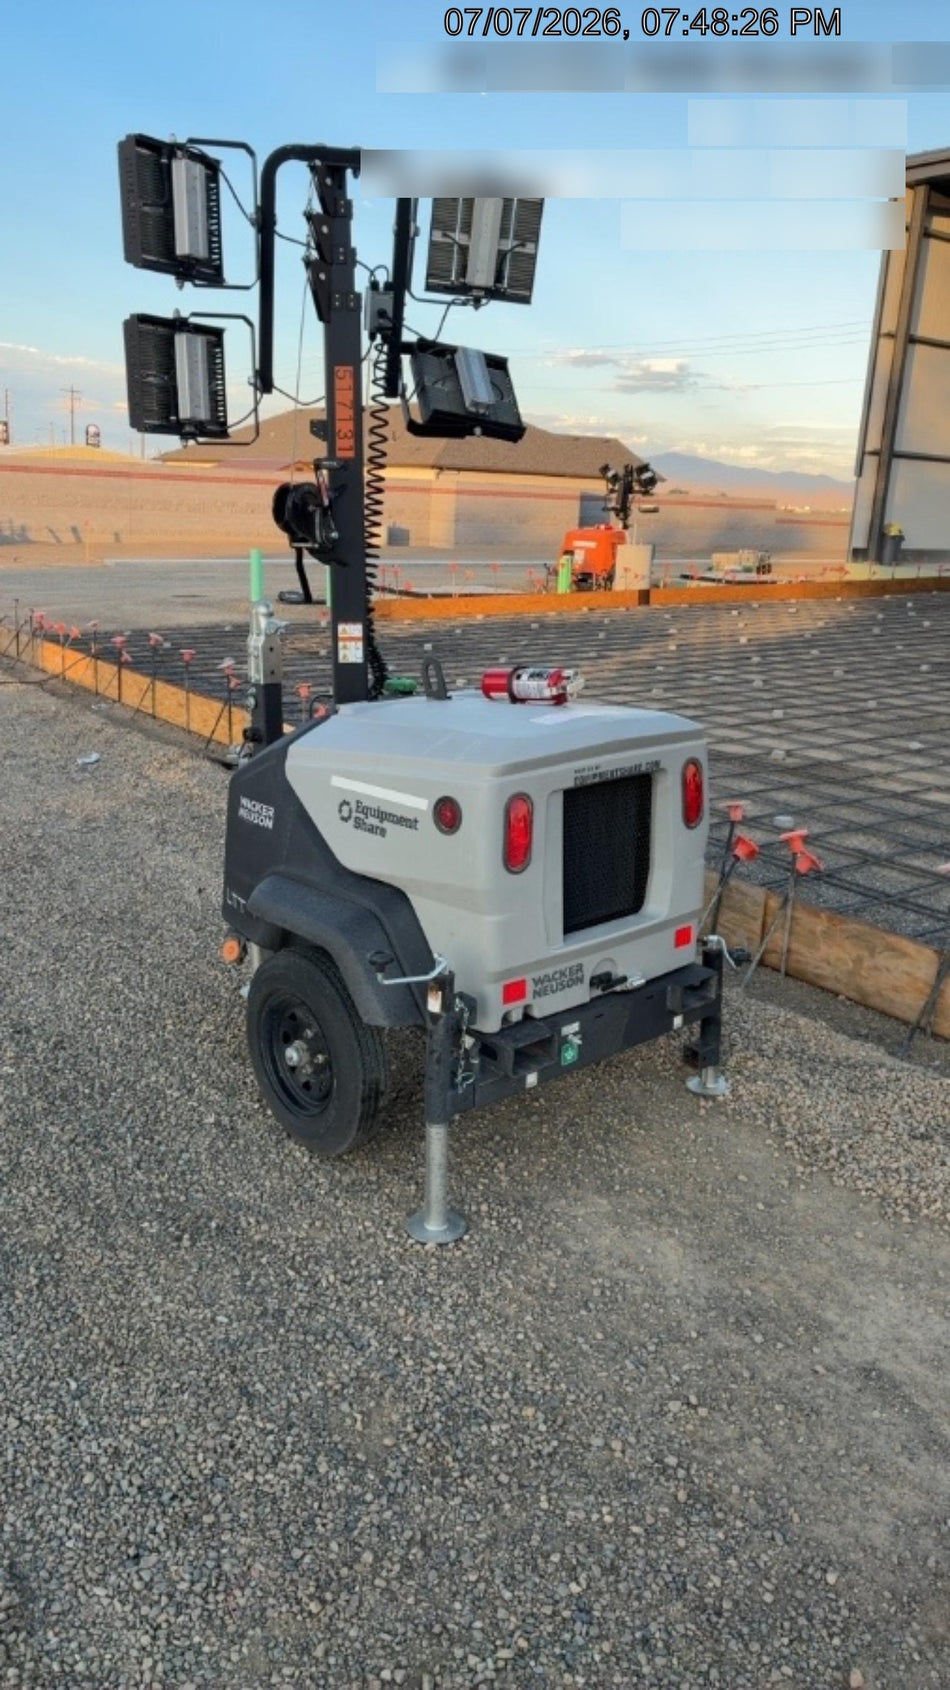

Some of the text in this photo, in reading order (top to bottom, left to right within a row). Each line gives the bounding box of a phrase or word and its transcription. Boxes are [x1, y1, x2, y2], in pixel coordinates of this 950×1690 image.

[336, 369, 353, 451] 517131
[240, 795, 275, 816] WACKER
[355, 799, 419, 831] Equipment
[353, 816, 388, 838] Share
[532, 962, 585, 988] WACKER
[532, 974, 584, 1000] NEUSON
